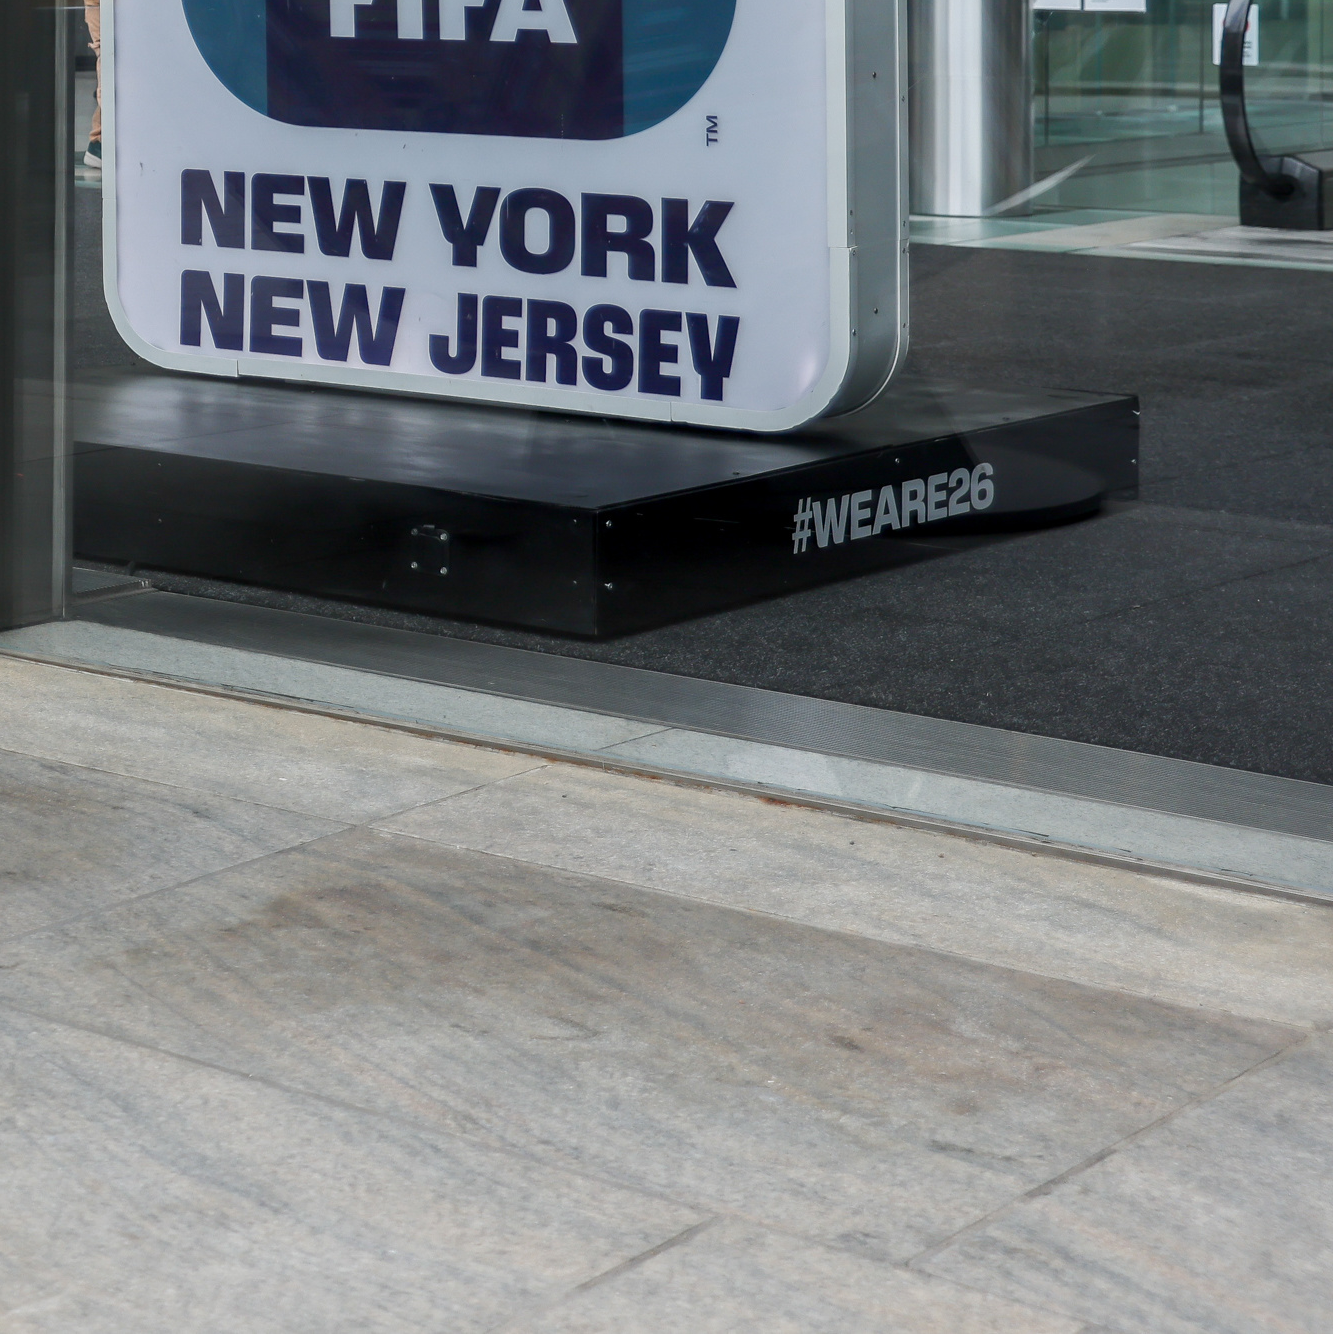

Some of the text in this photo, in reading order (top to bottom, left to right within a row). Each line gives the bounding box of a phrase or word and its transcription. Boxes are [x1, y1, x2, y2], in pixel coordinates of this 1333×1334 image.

[706, 114, 719, 146] TM
[181, 169, 738, 289] NEW YORK
[180, 269, 740, 401] NEW JERSEY
[791, 462, 994, 554] #WEARE26
